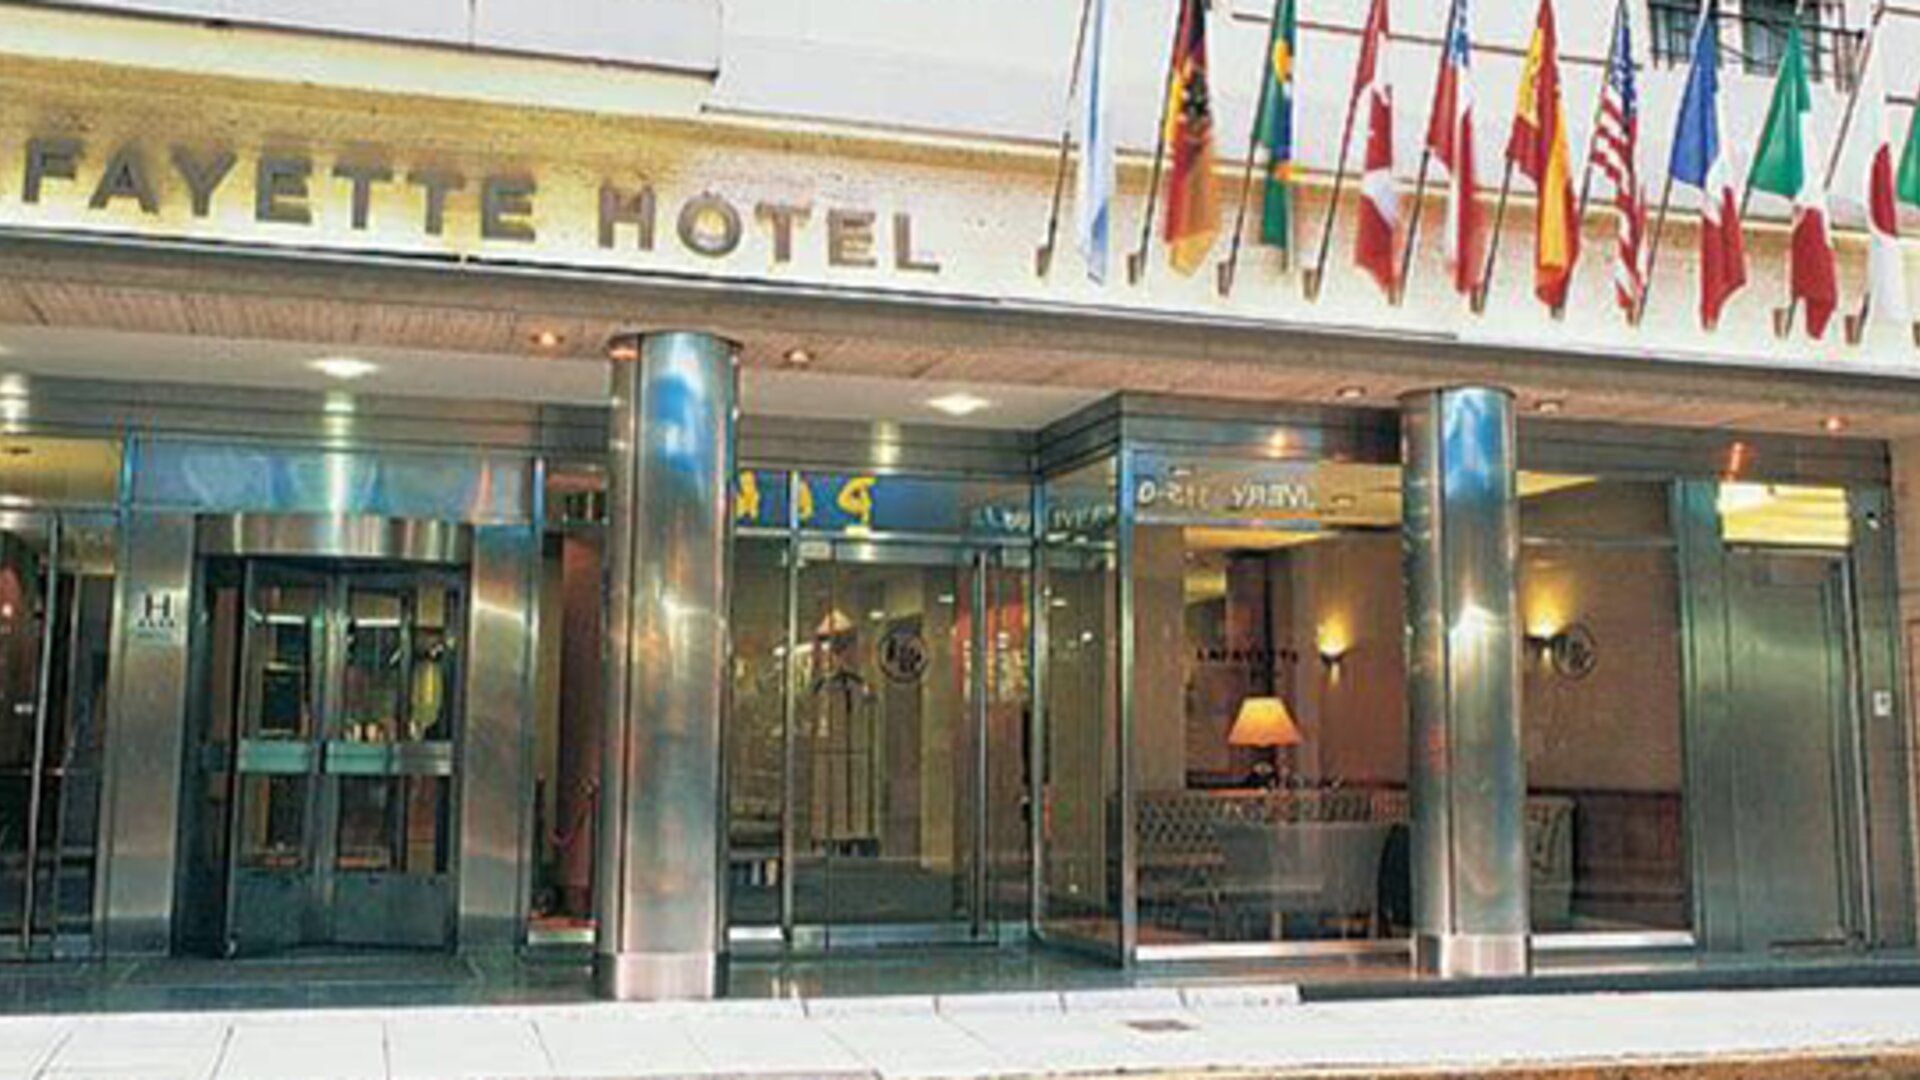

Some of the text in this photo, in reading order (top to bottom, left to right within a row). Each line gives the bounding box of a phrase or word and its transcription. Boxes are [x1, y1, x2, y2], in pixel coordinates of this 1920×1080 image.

[22, 137, 942, 274] FAYETTE HOTEL
[144, 593, 172, 619] H
